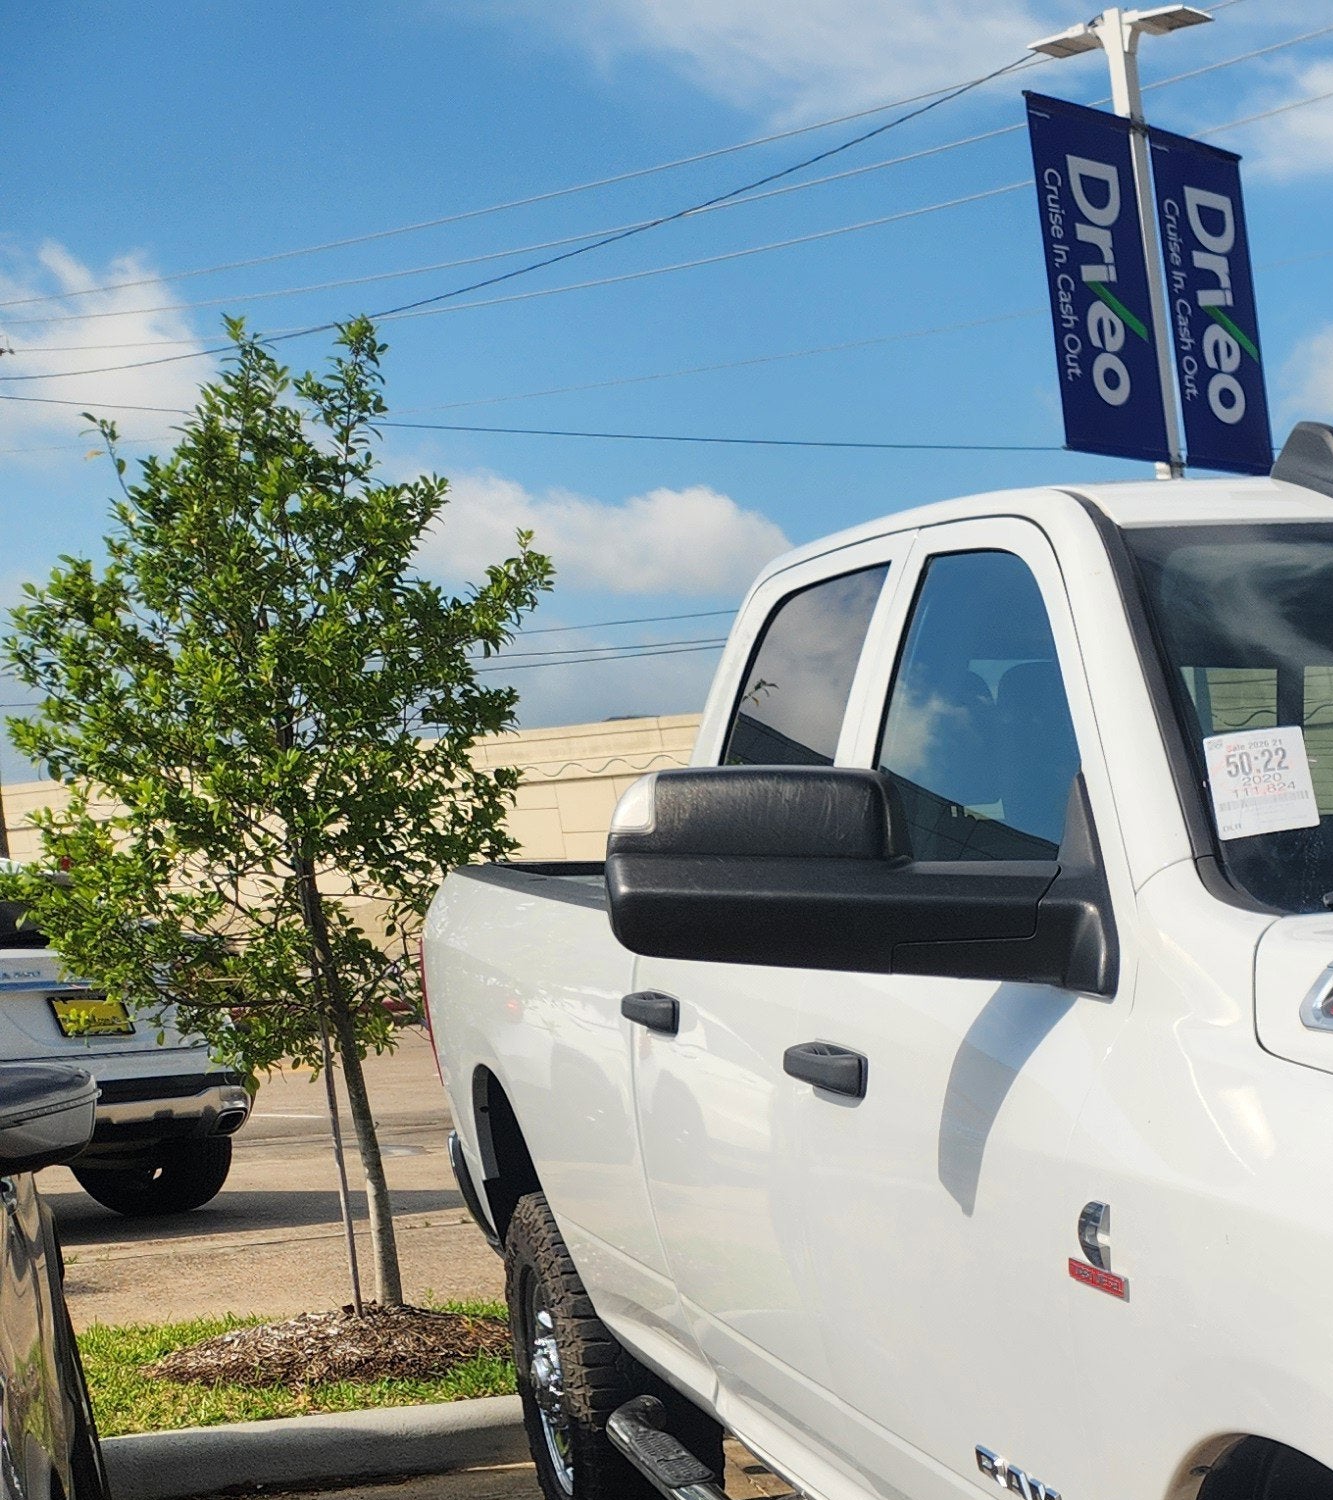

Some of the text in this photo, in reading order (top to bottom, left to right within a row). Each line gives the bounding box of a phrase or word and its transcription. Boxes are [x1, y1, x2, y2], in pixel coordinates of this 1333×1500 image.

[1043, 168, 1084, 382] Cruise In. Cash Out.
[1162, 198, 1200, 402] Cruise In. Cash Out.
[1242, 773, 1282, 787] 2020
